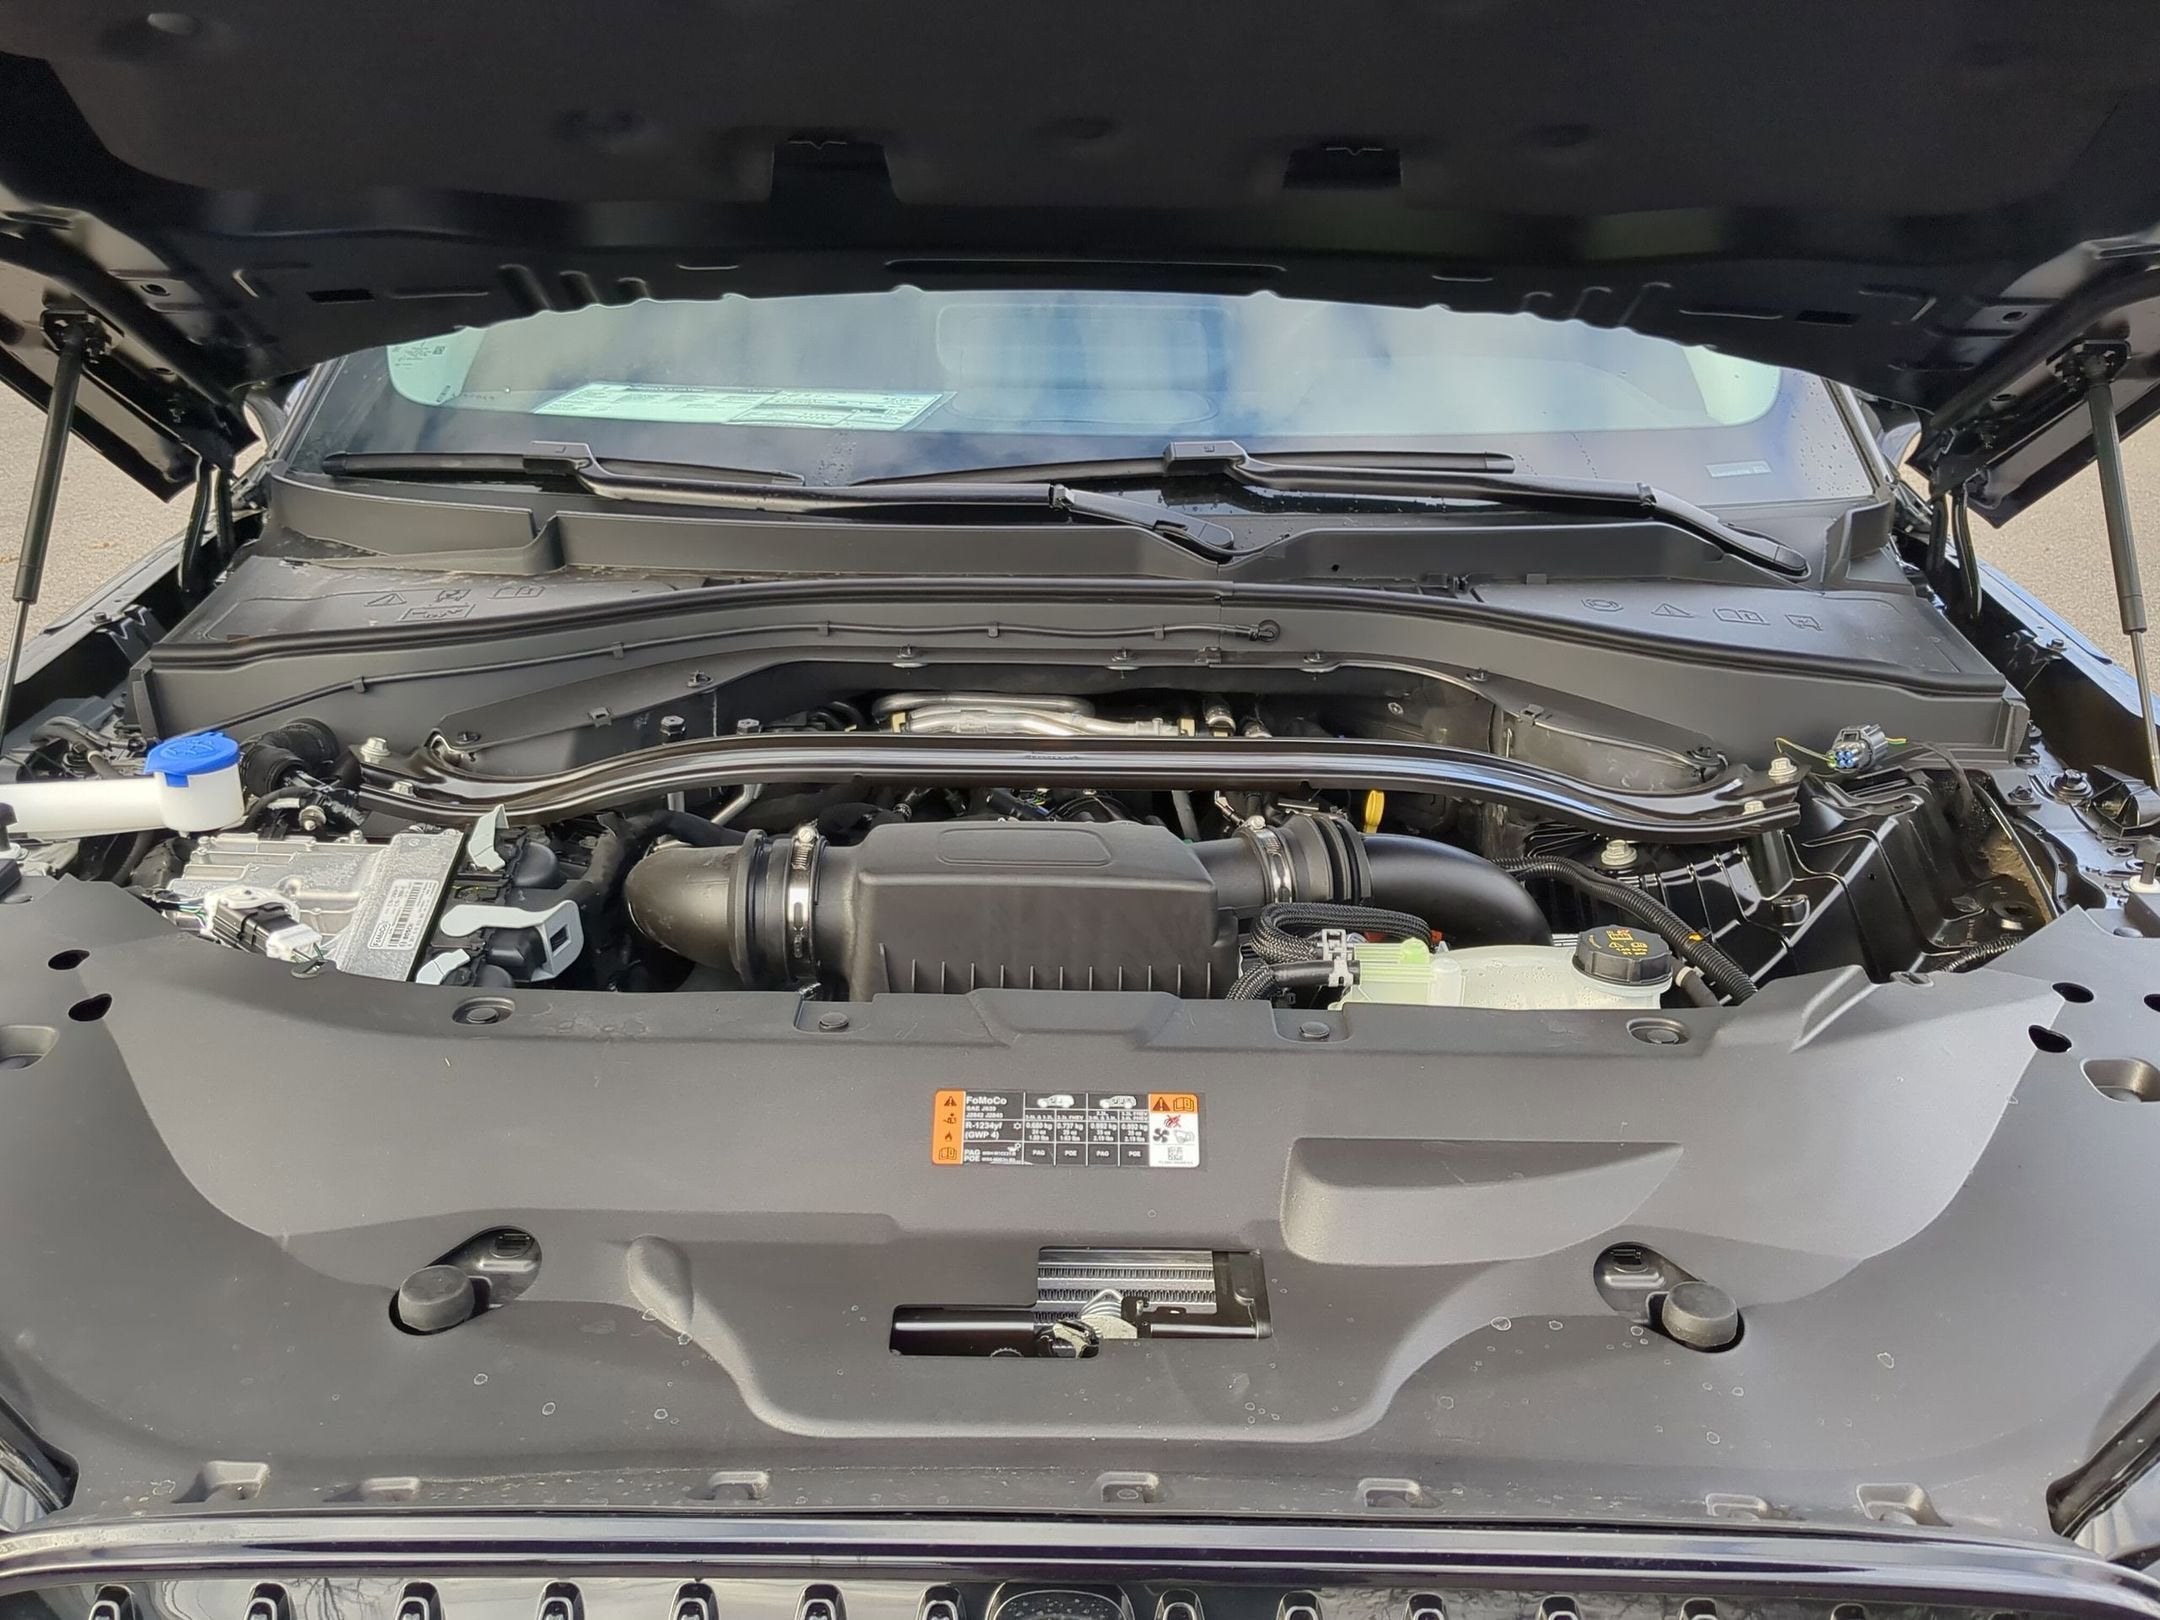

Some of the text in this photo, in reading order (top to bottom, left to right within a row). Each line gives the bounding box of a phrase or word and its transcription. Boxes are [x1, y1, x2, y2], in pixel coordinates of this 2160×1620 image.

[966, 1096, 1007, 1105] FoMoCo
[965, 1121, 1003, 1131] R-1234yf
[965, 1131, 989, 1140] (GWP
